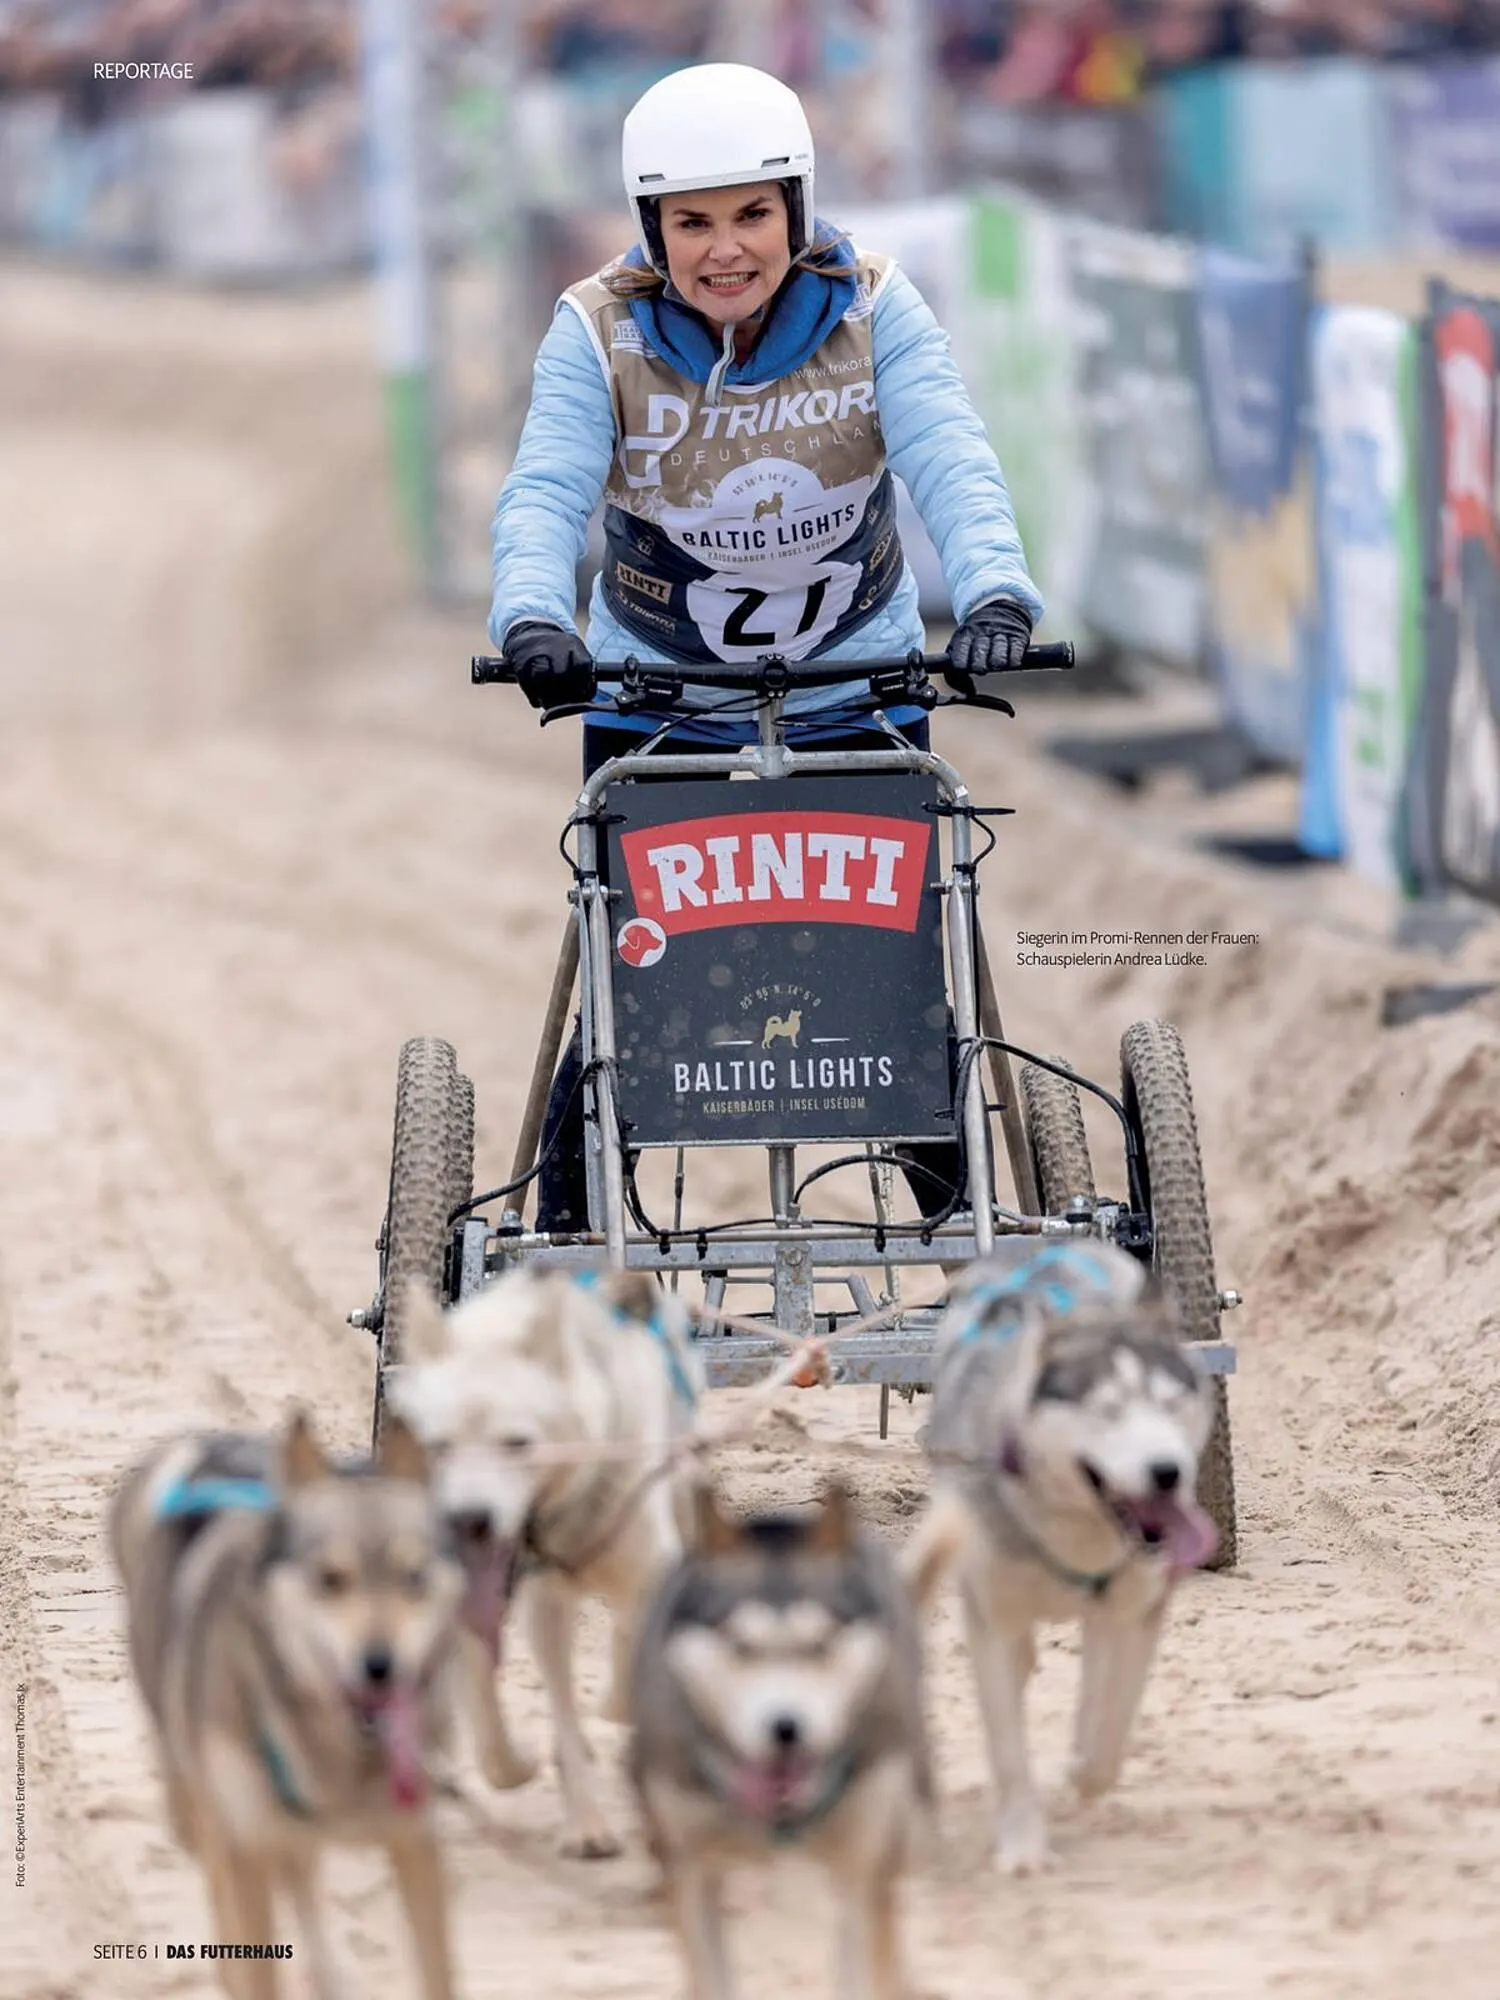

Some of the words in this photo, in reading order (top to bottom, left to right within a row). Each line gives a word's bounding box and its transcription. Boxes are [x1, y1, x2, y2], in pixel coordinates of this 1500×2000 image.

[700, 380, 876, 440] TRIKOR
[682, 530, 766, 550] BALTIC
[777, 504, 855, 546] LIGHTS
[647, 832, 905, 913] RINTI
[674, 1060, 776, 1093] BALTIC
[790, 1056, 893, 1090] LIGHTS
[790, 1098, 819, 1111] INSEL
[823, 1097, 866, 1110] USEDOM
